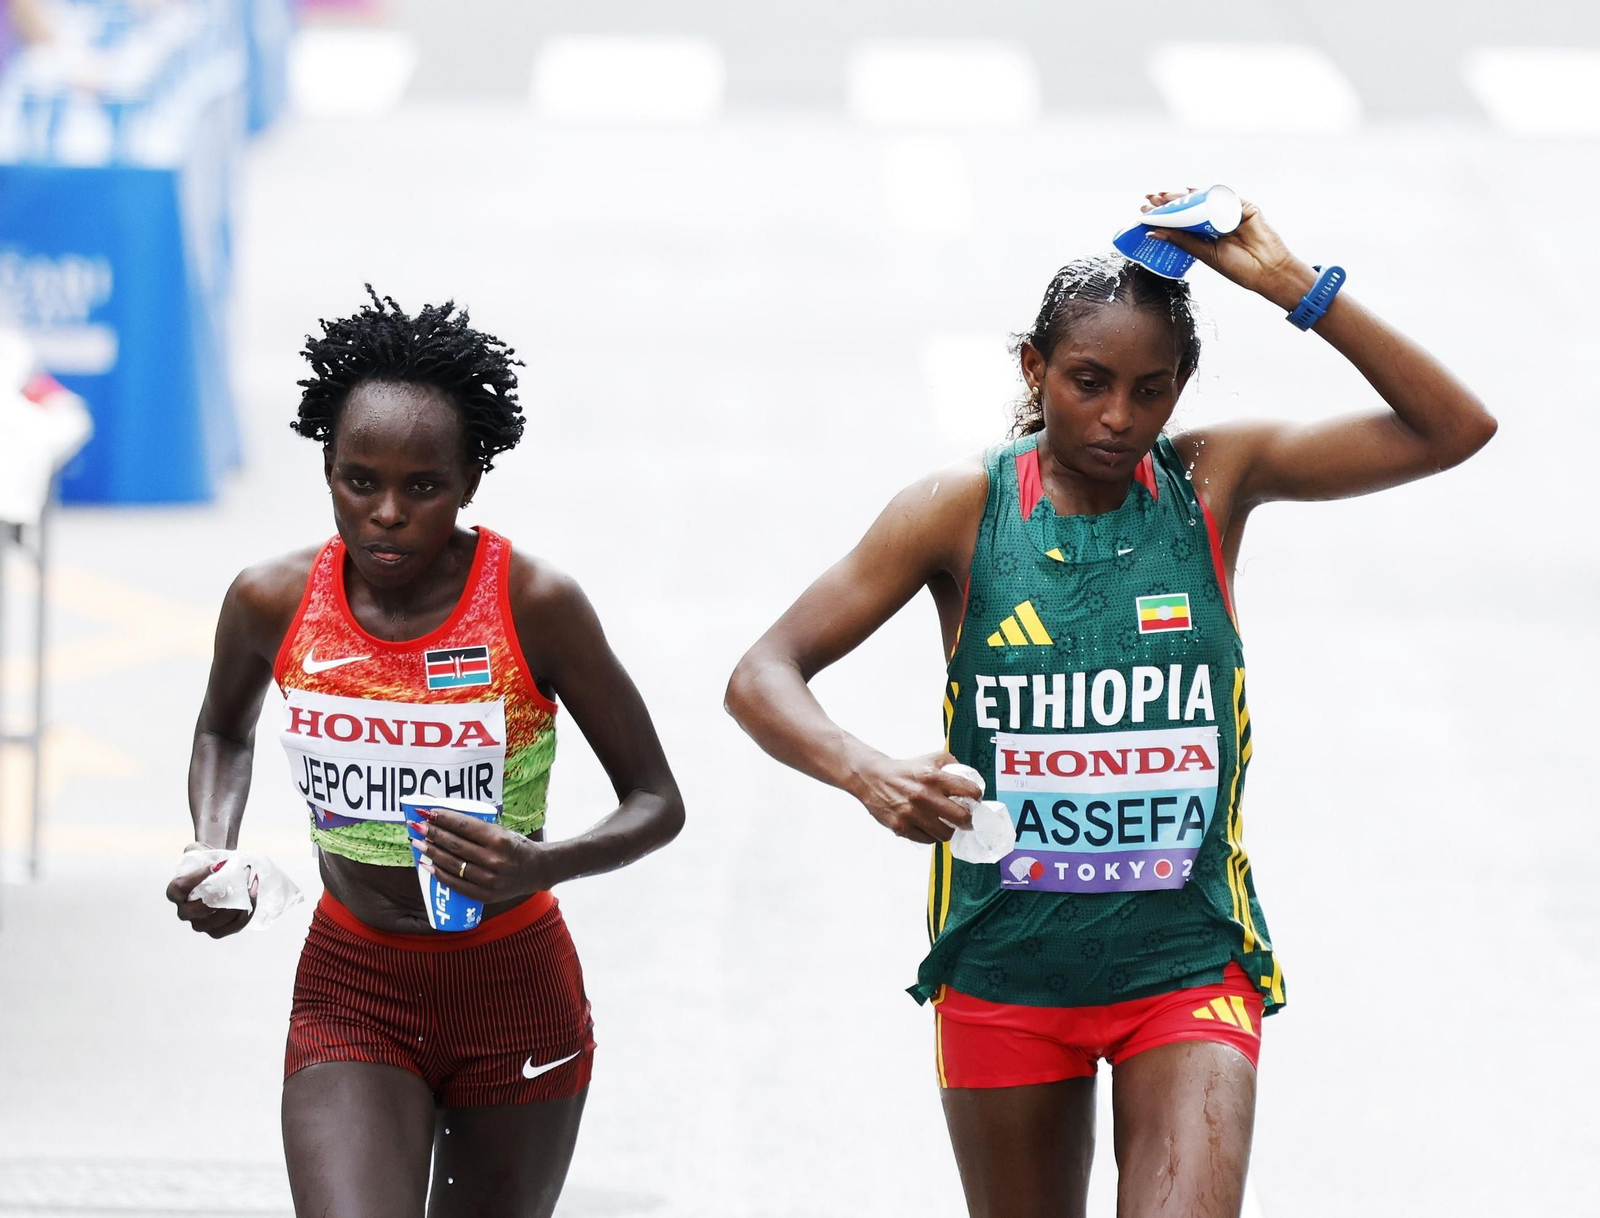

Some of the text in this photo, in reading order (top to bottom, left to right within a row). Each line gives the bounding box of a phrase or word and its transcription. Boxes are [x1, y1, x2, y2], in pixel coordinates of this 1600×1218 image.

[975, 664, 1215, 730] ETHIOPIA
[285, 706, 500, 748] HONDA
[1000, 744, 1215, 777] HONDA
[1015, 795, 1205, 846] ASSEFA
